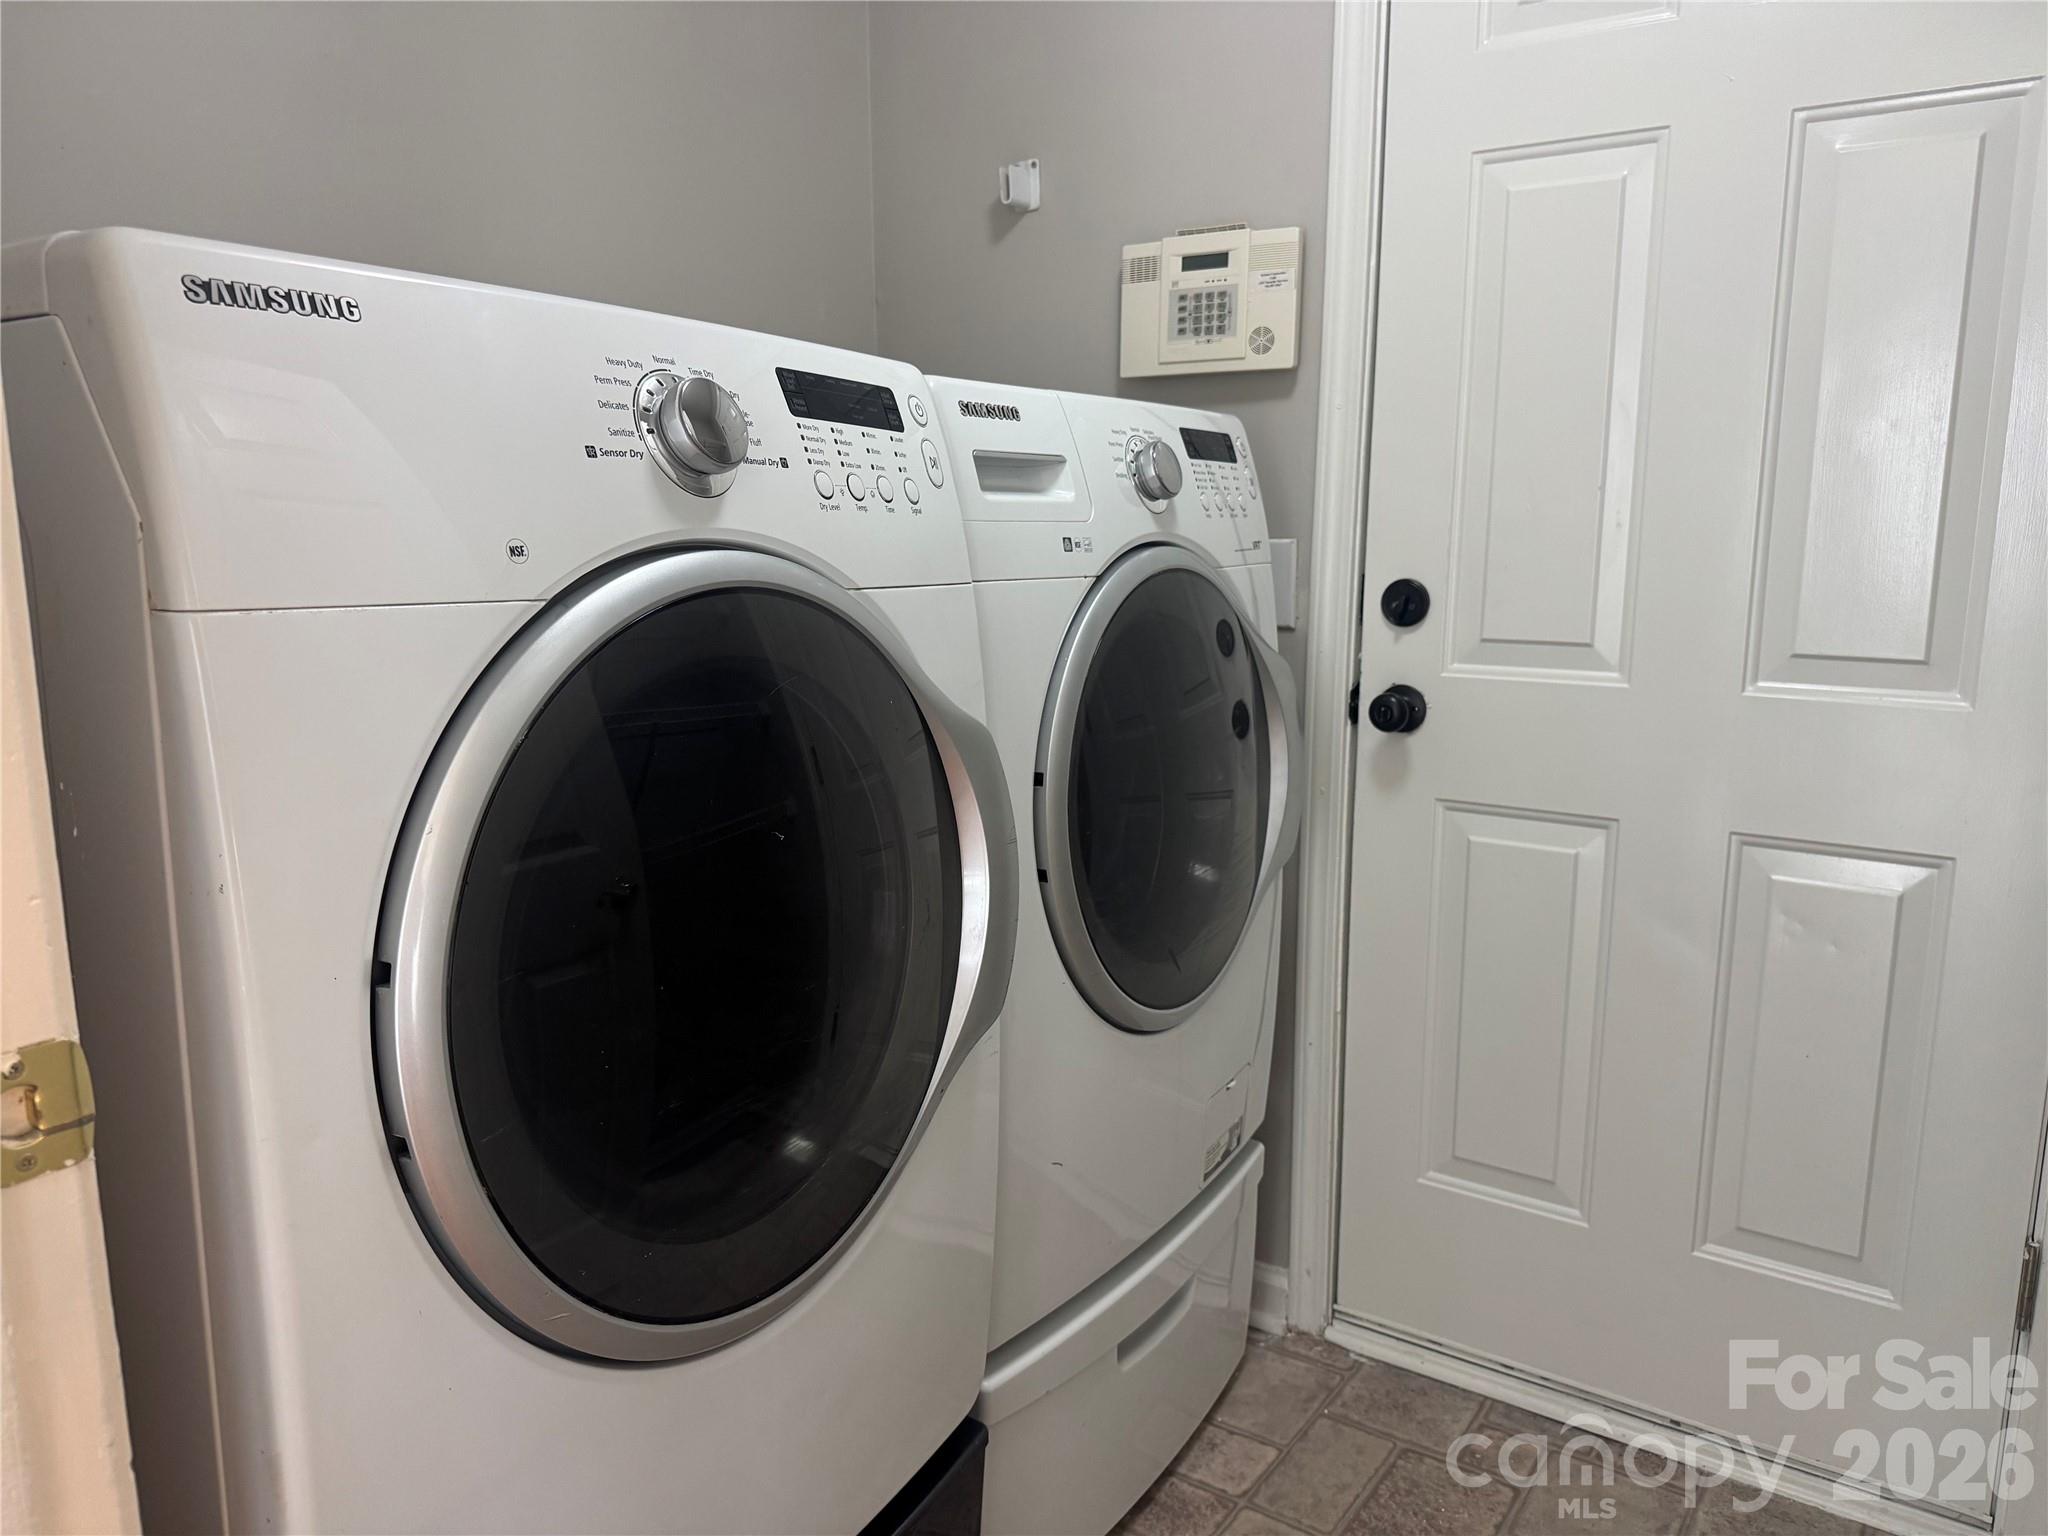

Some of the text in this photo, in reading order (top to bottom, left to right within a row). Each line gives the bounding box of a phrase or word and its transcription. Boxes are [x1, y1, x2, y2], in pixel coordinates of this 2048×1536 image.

[181, 274, 361, 323] SAMSUNG
[605, 356, 643, 370] Heavy Duty
[652, 355, 676, 365] Normal
[688, 367, 714, 380] Time Dry
[594, 375, 632, 387] Perm Press
[598, 400, 630, 410] Delicates
[958, 400, 1021, 422] SAMSUNG
[608, 427, 635, 437] Sanitize
[599, 448, 644, 460] Sensor Dry
[743, 457, 779, 468] Manual Dry
[819, 502, 841, 512] Dry Level
[508, 545, 525, 557] NSF
